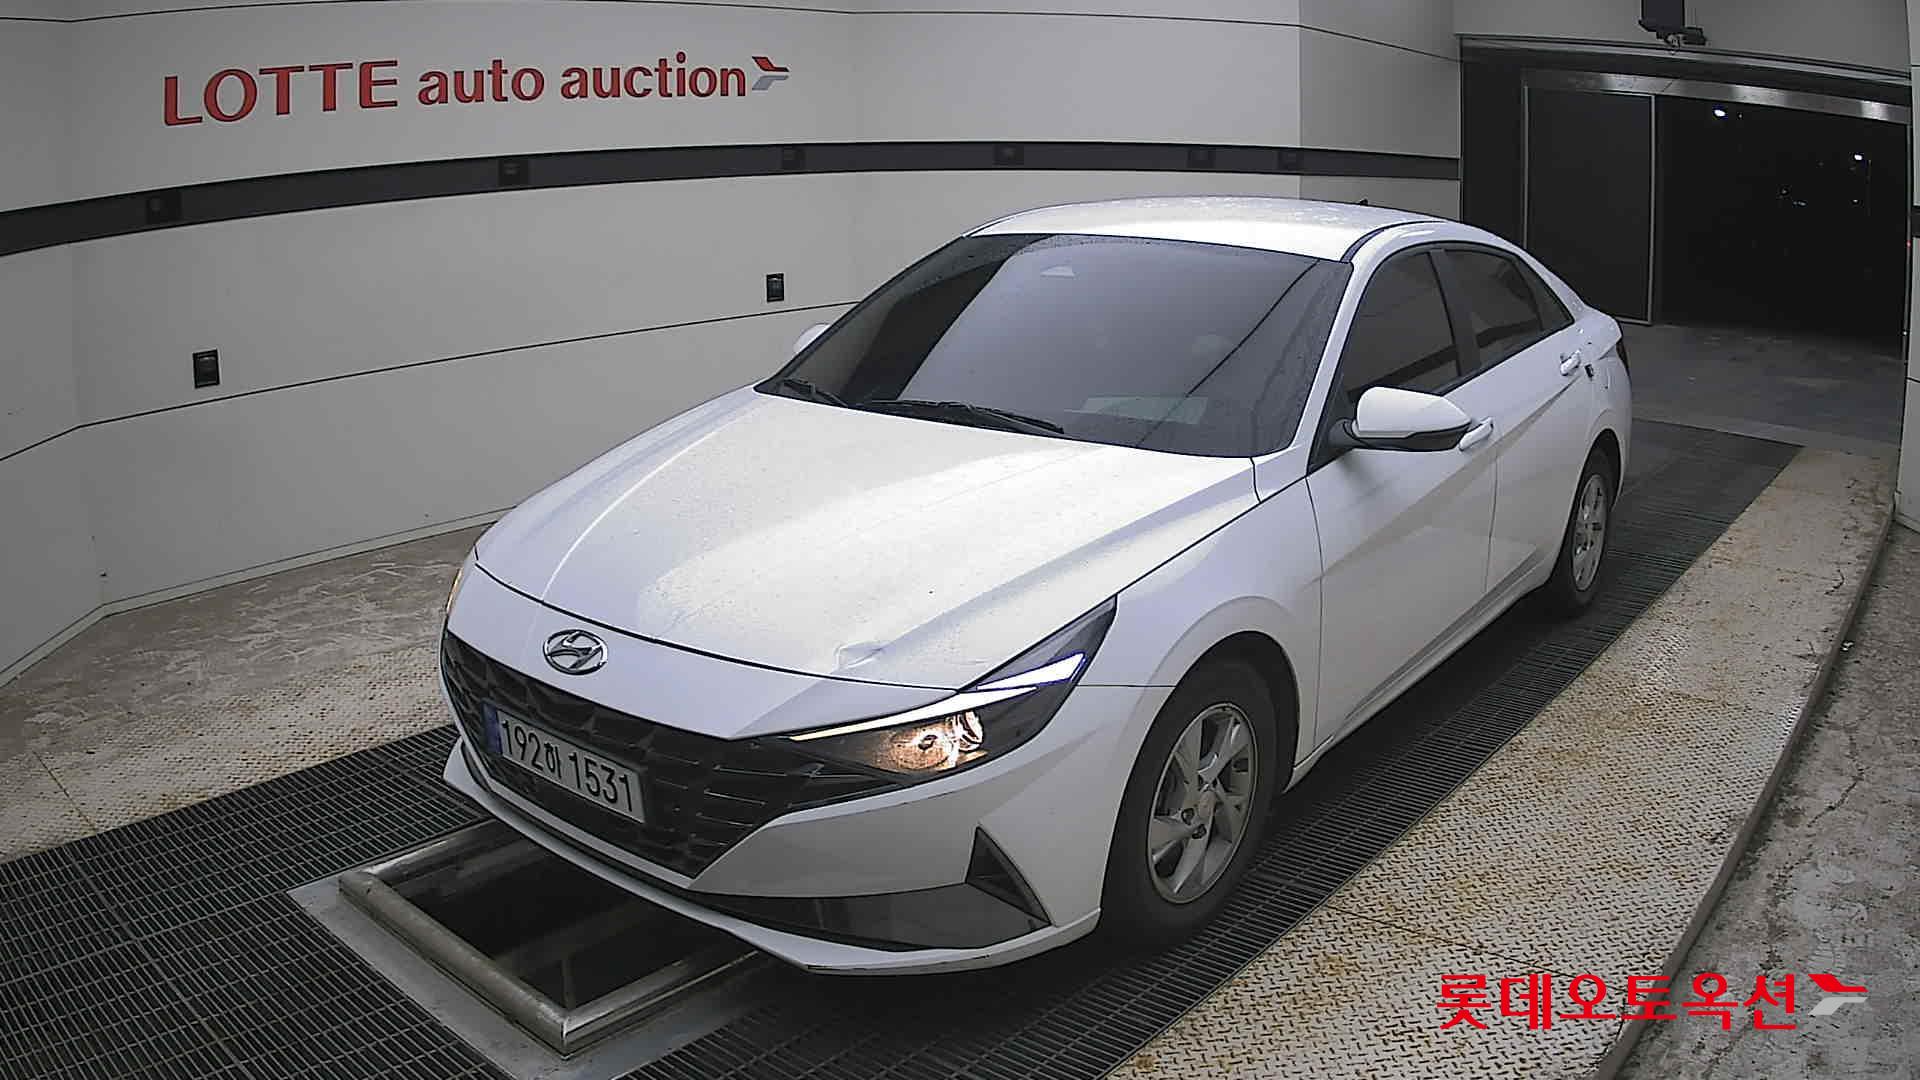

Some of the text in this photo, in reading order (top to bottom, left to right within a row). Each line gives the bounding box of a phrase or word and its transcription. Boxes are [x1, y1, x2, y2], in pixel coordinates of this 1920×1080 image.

[164, 51, 746, 126] LOTTE auto auction
[569, 752, 633, 812] 1531
